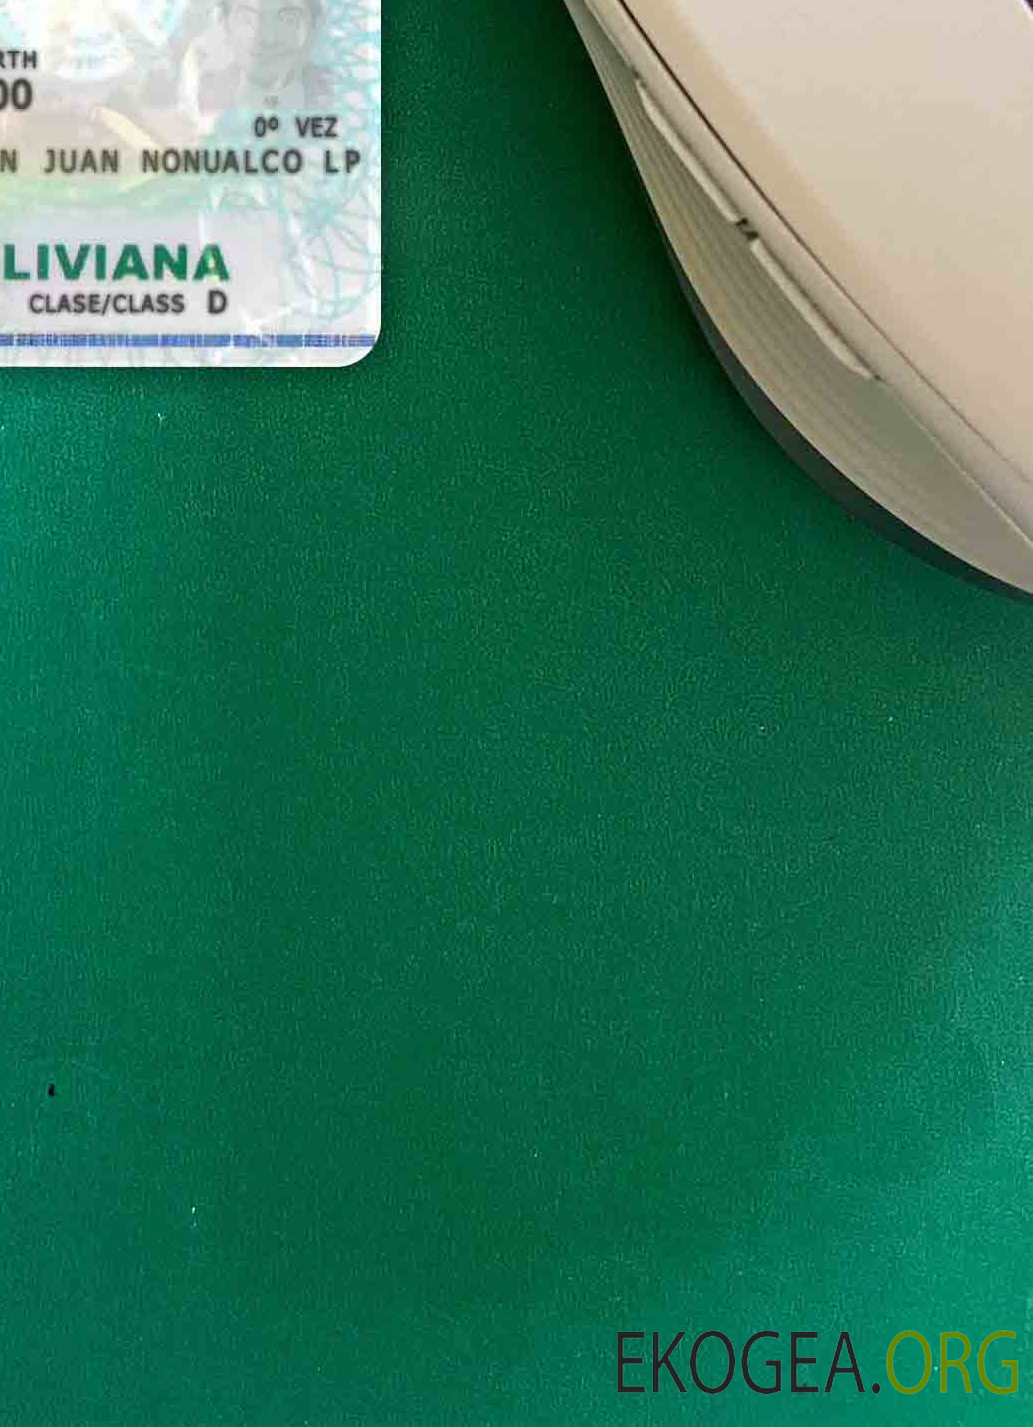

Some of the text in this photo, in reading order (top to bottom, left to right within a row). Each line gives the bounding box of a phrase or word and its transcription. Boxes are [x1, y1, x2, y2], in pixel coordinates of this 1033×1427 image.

[295, 116, 339, 138] VEZ
[44, 149, 120, 174] JUAN
[141, 148, 304, 174] NONUALCO
[2, 243, 231, 281] LIVIANA
[28, 289, 228, 317] CLASE/CLASS D
